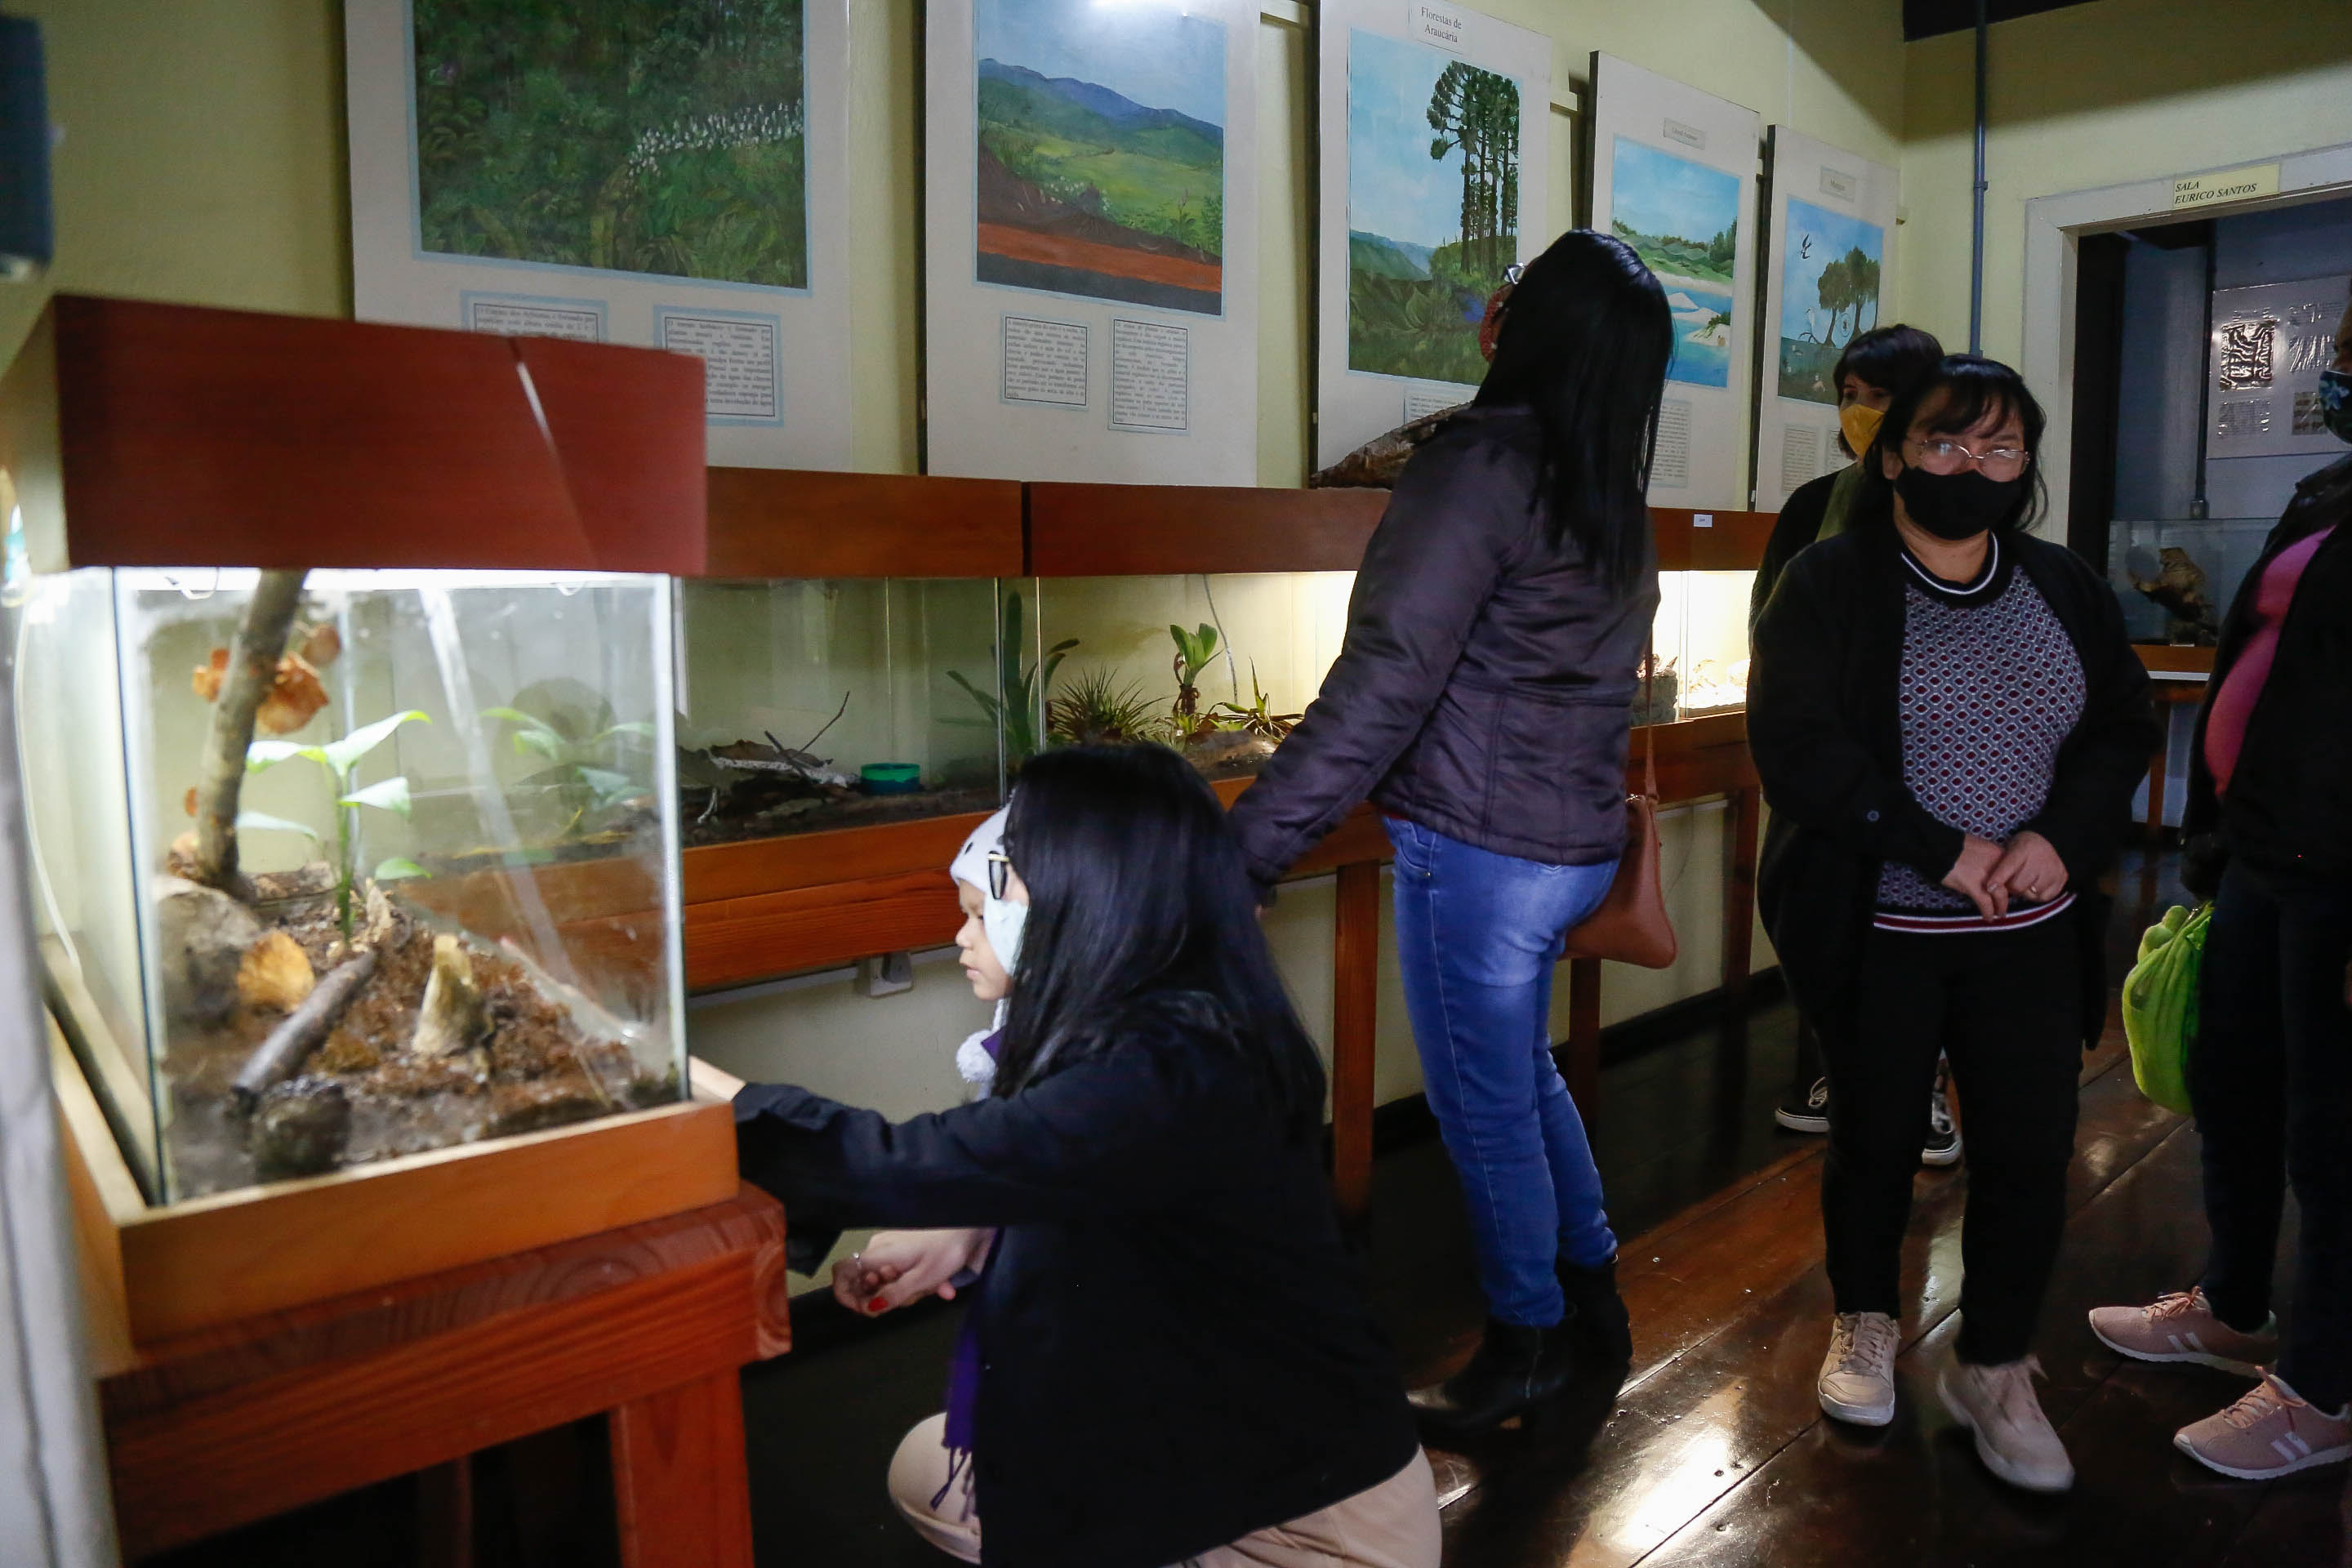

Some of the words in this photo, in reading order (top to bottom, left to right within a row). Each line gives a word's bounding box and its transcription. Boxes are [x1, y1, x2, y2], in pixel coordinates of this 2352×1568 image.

[1421, 7, 1452, 26] Florestas
[1454, 18, 1462, 29] de
[1424, 24, 1458, 42] Araucária
[2174, 190, 2215, 204] EURICO
[2216, 183, 2257, 198] SANTOS
[2175, 180, 2200, 192] SALA
